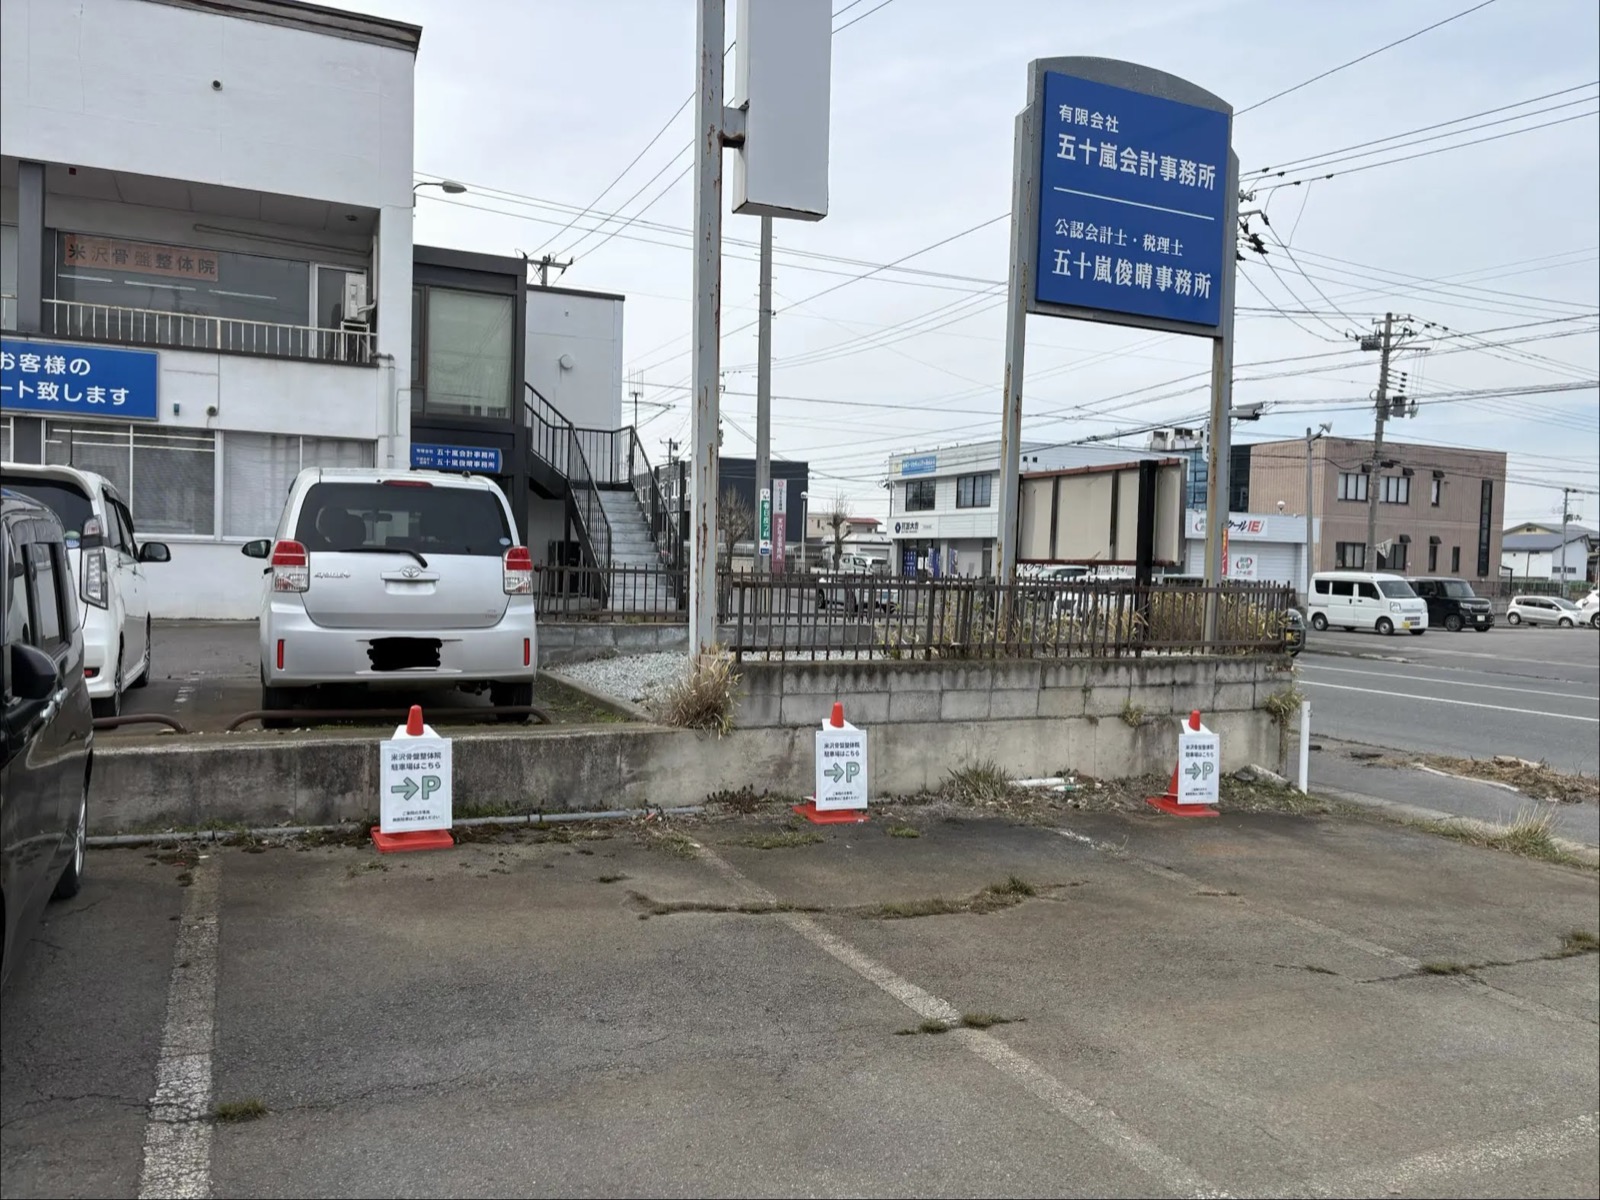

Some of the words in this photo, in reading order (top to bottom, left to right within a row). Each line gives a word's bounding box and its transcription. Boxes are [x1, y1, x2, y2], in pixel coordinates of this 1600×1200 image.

[1058, 104, 1119, 133] 有限会社
[1056, 133, 1216, 190] 五十嵐会計事務所
[1054, 218, 1183, 256] 公認会計士・税理士
[68, 243, 216, 275] 米沢骨盤整体院
[1052, 248, 1212, 299] 五十嵐俊晴事務所
[1, 351, 91, 376] お客様の
[391, 752, 442, 761] 米沢骨盤整体院
[391, 761, 441, 771] 駐車場はこちら
[846, 761, 860, 783] P
[1202, 761, 1214, 780] P
[421, 775, 442, 800] P
